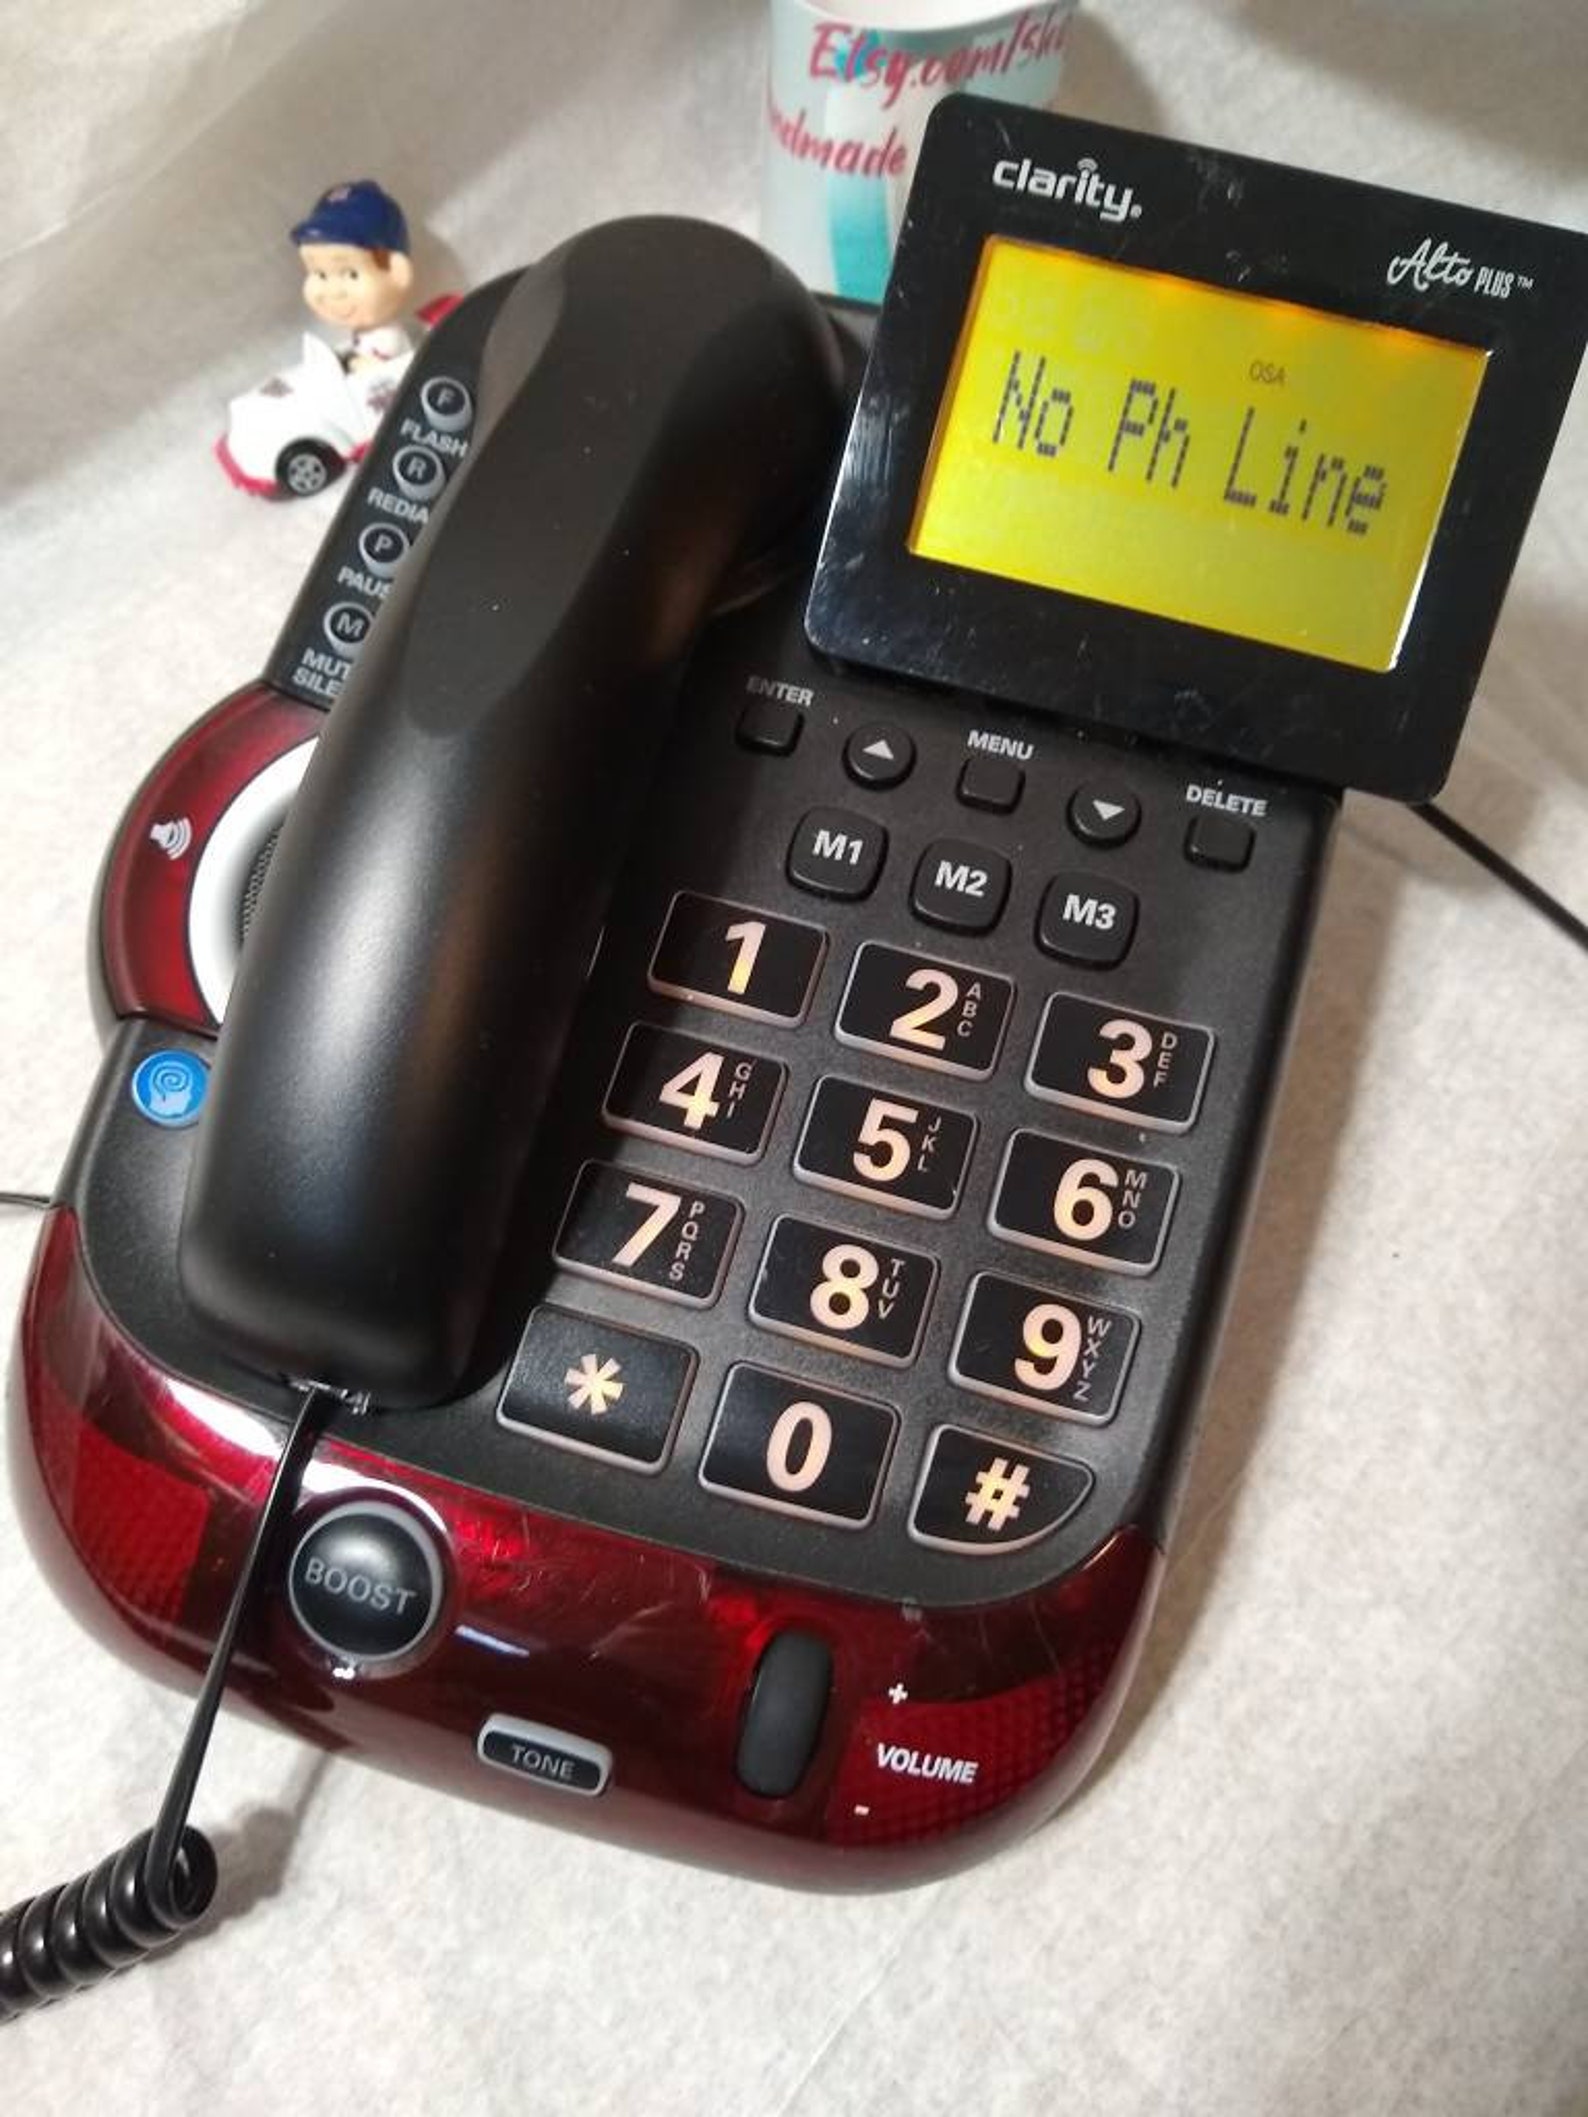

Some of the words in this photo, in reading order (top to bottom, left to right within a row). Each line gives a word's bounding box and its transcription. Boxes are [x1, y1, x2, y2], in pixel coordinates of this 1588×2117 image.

[1387, 237, 1475, 291] Alto
[1474, 266, 1515, 299] PLUS
[437, 388, 453, 408] F
[400, 418, 469, 458] FLASH
[992, 350, 1074, 457] No
[1108, 379, 1191, 489] Ph
[1223, 406, 1388, 535] Line
[407, 457, 427, 480] R
[367, 487, 430, 524] REDIA
[374, 534, 393, 552] P
[337, 565, 393, 600] PAUS
[337, 612, 363, 637] M
[302, 648, 351, 680] MUT
[747, 675, 814, 707] ENTER
[968, 729, 1034, 762] MENU
[1186, 784, 1268, 817] DELETE
[813, 829, 863, 866] M1
[934, 860, 988, 898] M2
[1063, 894, 1117, 931] M3
[724, 921, 767, 995] 1
[889, 968, 959, 1051] 2
[1086, 1018, 1153, 1099] 3
[659, 1051, 725, 1129] 4
[852, 1098, 919, 1182] 5
[1053, 1158, 1119, 1241] 6
[612, 1183, 681, 1267] 7
[809, 1244, 879, 1330] 8
[1014, 1303, 1081, 1391] 9
[765, 1401, 833, 1492] 0
[305, 1559, 418, 1616] BOOST
[510, 1743, 576, 1782] TONE
[875, 1742, 979, 1784] VOLUME
